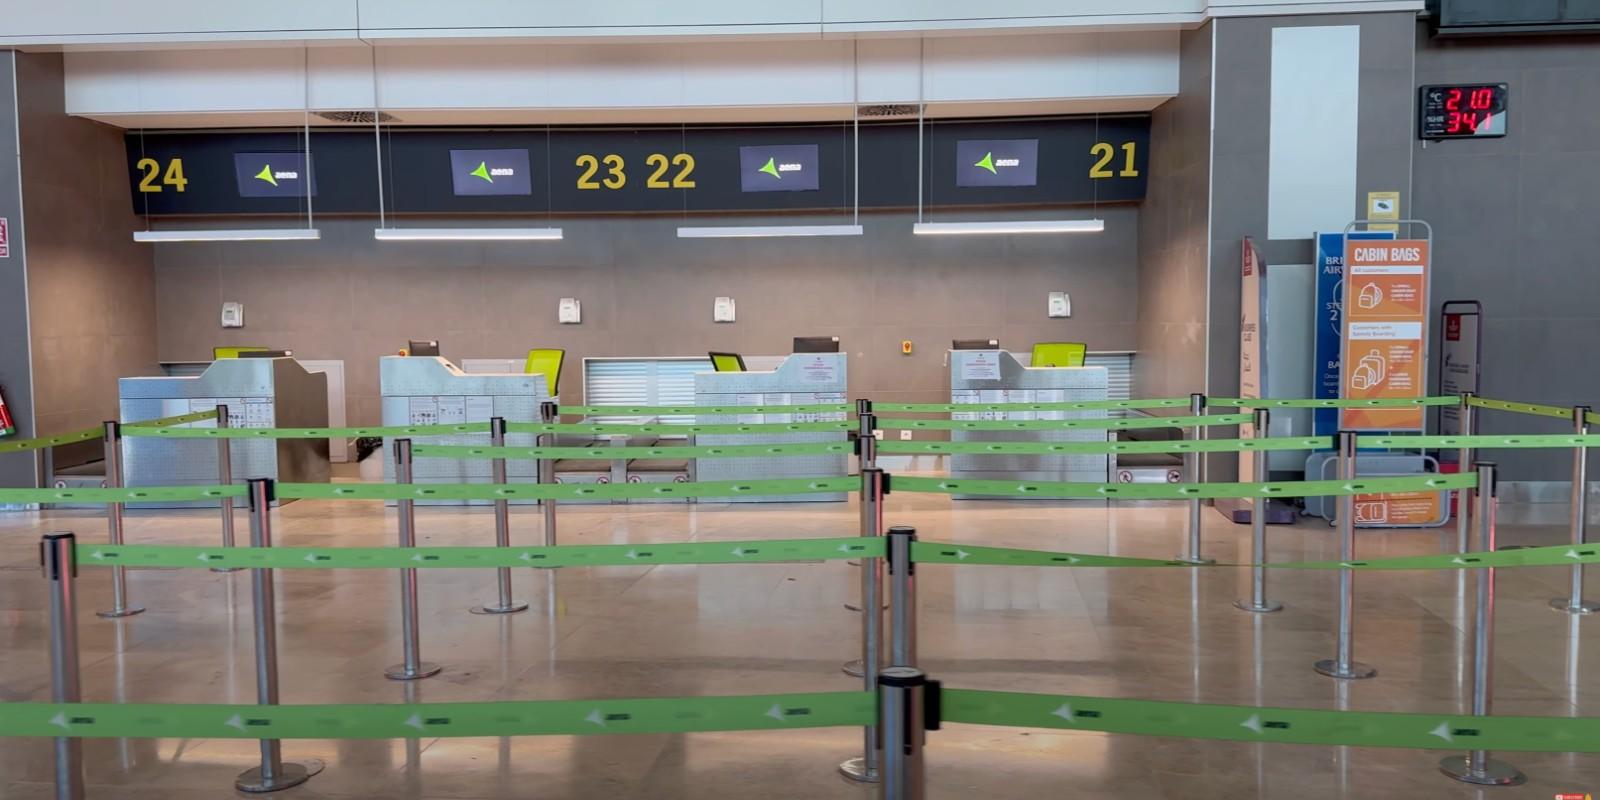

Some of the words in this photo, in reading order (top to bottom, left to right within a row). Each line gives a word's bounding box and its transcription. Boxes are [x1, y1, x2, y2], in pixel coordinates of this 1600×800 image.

[1446, 88, 1493, 110] 21.0
[136, 158, 188, 192] 24
[575, 154, 626, 189] 23
[646, 153, 696, 188] 22
[1089, 142, 1139, 178] 21
[1354, 247, 1388, 262] CABIN
[1391, 247, 1420, 262] BAGS
[1329, 309, 1338, 321] 2
